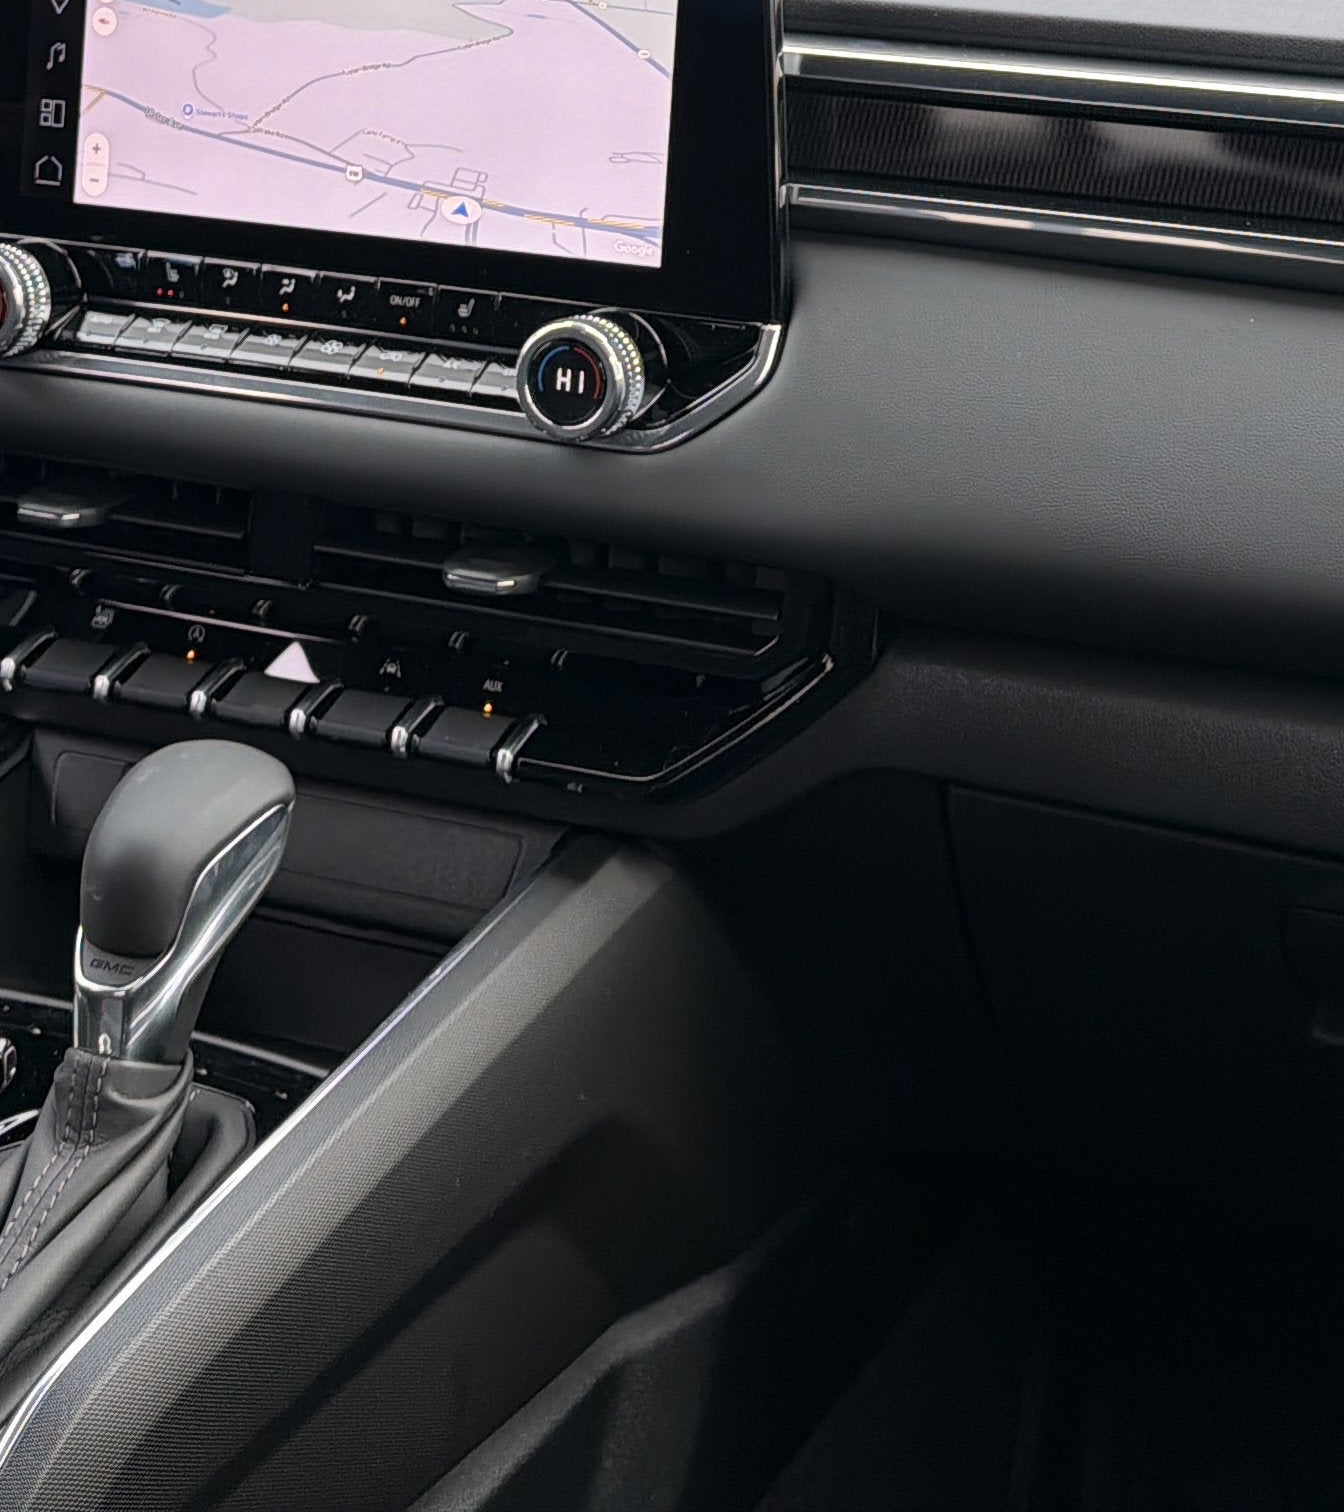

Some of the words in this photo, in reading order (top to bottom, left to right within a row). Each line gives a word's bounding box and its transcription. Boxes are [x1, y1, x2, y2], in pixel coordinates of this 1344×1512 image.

[615, 238, 656, 257] Google
[390, 294, 421, 308] ON/OFF
[556, 367, 585, 395] HI
[90, 958, 134, 976] GMC
